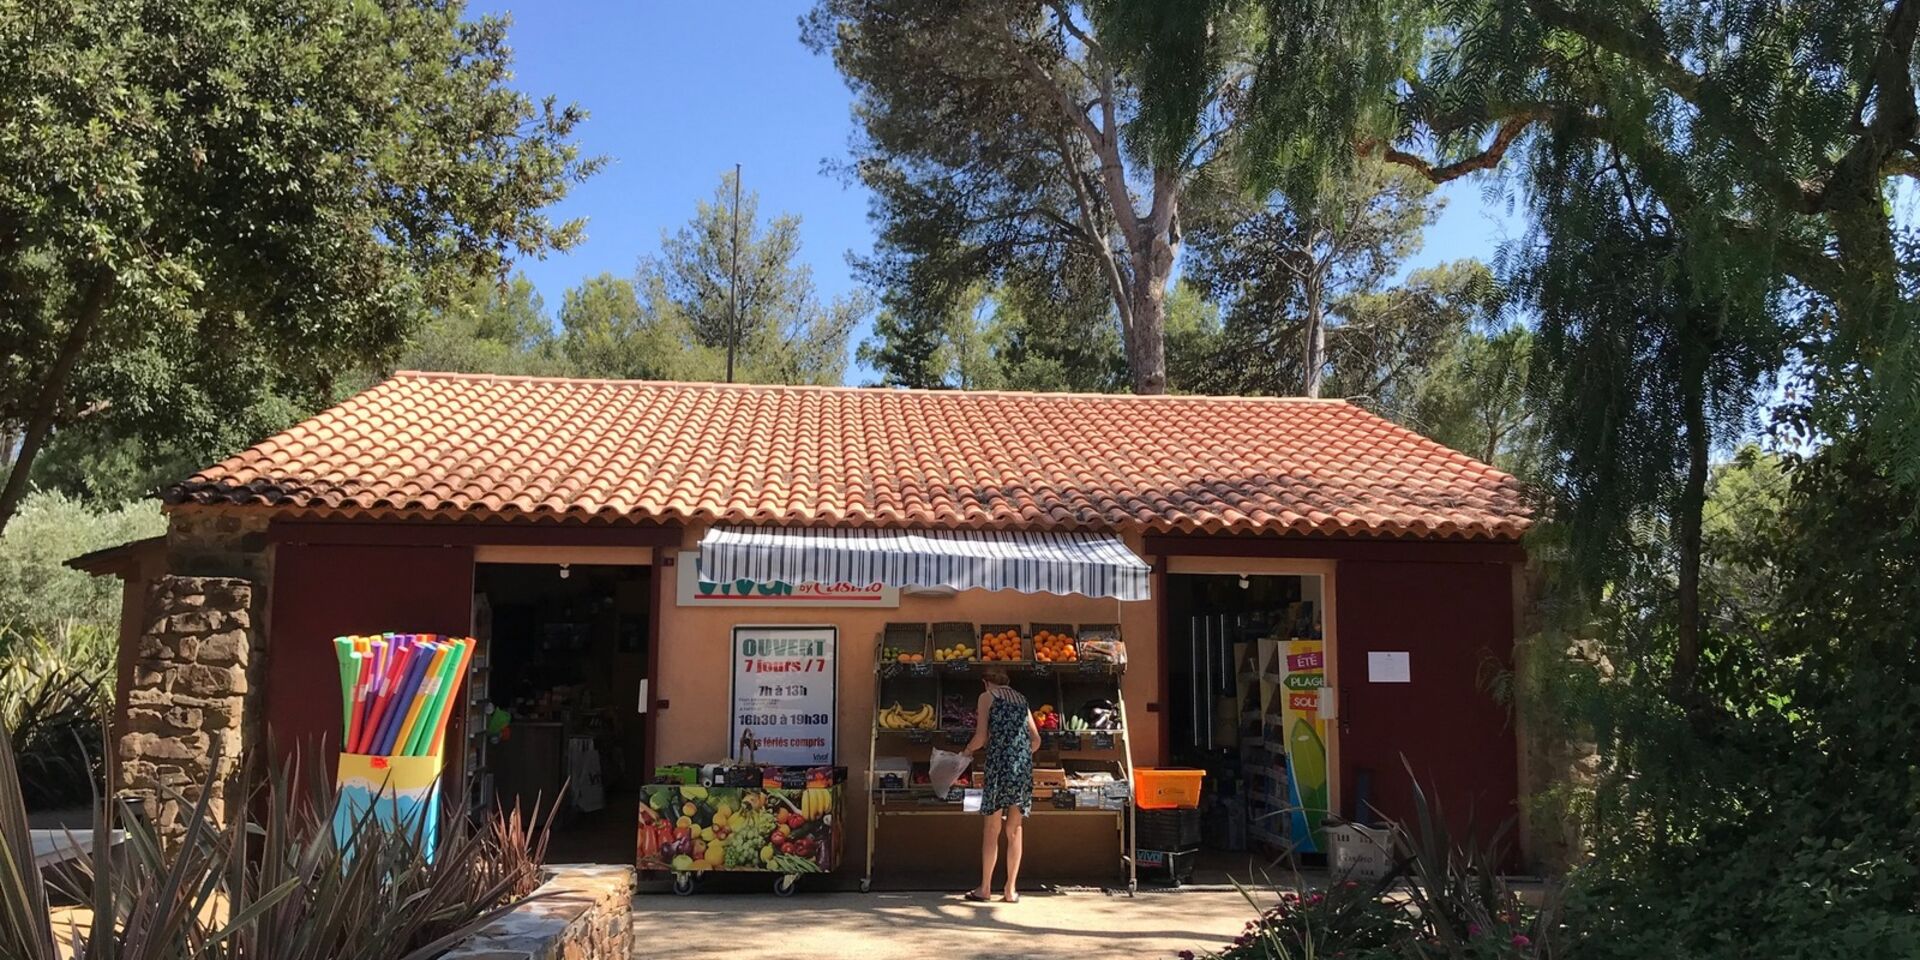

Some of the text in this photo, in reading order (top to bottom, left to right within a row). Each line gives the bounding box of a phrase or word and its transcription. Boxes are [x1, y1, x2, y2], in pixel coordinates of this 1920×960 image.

[742, 639, 826, 656] OUVERT
[744, 660, 753, 672] 7
[756, 660, 801, 673] jours
[816, 659, 825, 672] 7
[1297, 654, 1317, 667] ÉTÉ
[759, 685, 808, 696] 7h à 13h
[739, 714, 829, 725] 16h30 à 19h30
[790, 737, 825, 747] compris
